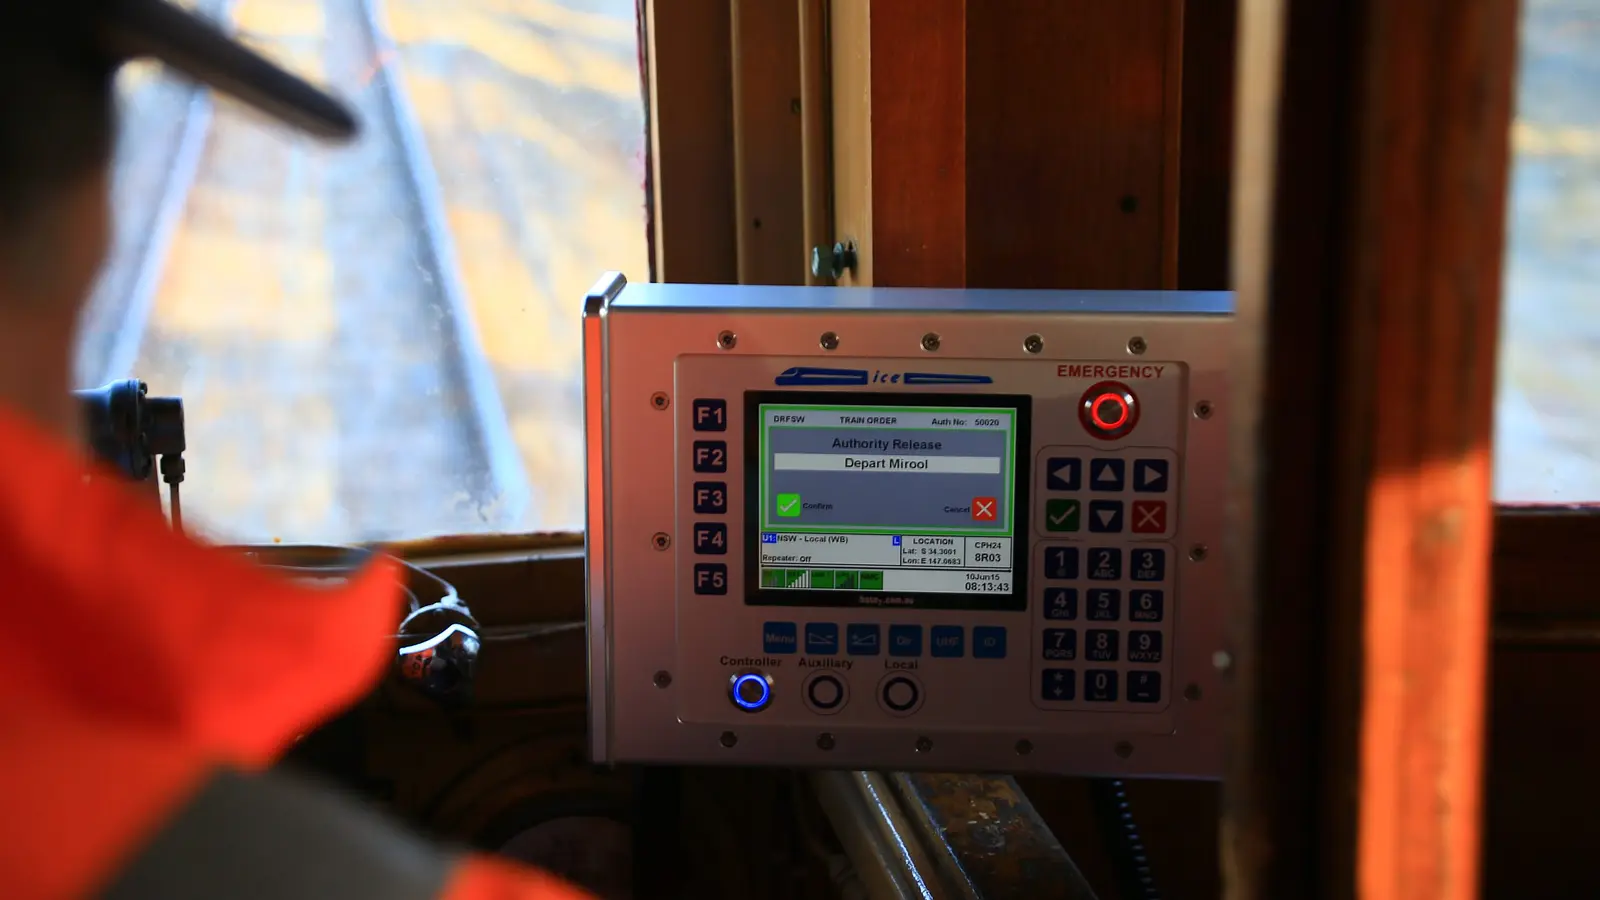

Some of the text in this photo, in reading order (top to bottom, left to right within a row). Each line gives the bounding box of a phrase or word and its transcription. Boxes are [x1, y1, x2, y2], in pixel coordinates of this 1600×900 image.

[873, 370, 900, 384] ice
[1057, 364, 1164, 379] EMERGENCY
[697, 406, 723, 424] F1
[773, 415, 805, 424] DRFSW
[840, 416, 897, 425] TRAIN ORDER
[932, 417, 1000, 427] Auth No: 50020
[832, 438, 942, 451] Authority Release
[697, 448, 723, 466] F2
[844, 457, 928, 470] Depart Mirool
[697, 489, 724, 507] F3
[802, 502, 833, 511] Confirm
[944, 505, 970, 513] Cancel
[697, 530, 724, 548] F4
[777, 535, 797, 543] NSW
[804, 535, 827, 543] Local
[828, 535, 849, 544] (WB)
[913, 538, 954, 546] LOCATION
[974, 541, 1002, 549] CPH24
[902, 547, 917, 555] Lat:
[762, 554, 812, 563] Repeater: Off
[902, 557, 919, 565] Lon:
[921, 557, 926, 565] E
[974, 553, 1001, 562] 8R03
[1055, 550, 1065, 567] 1
[1099, 551, 1110, 568] 2
[1142, 552, 1154, 569] 3
[965, 573, 1000, 581] 10Jun15
[1092, 568, 1115, 578] ABC
[1137, 569, 1157, 579] DEF
[697, 570, 724, 588] F5
[965, 581, 1010, 592] 08:13:43
[1054, 591, 1067, 608] 4
[1098, 592, 1109, 609] 5
[1140, 593, 1152, 610] 6
[765, 632, 795, 644] Menu
[1053, 631, 1066, 648] 7
[1096, 632, 1108, 649] 8
[1138, 633, 1151, 651] 9
[1092, 649, 1112, 660] TUV
[1129, 651, 1161, 661] WXYZ
[720, 656, 783, 667] Controller
[798, 657, 854, 671] Auxiliary
[884, 659, 918, 670] Local
